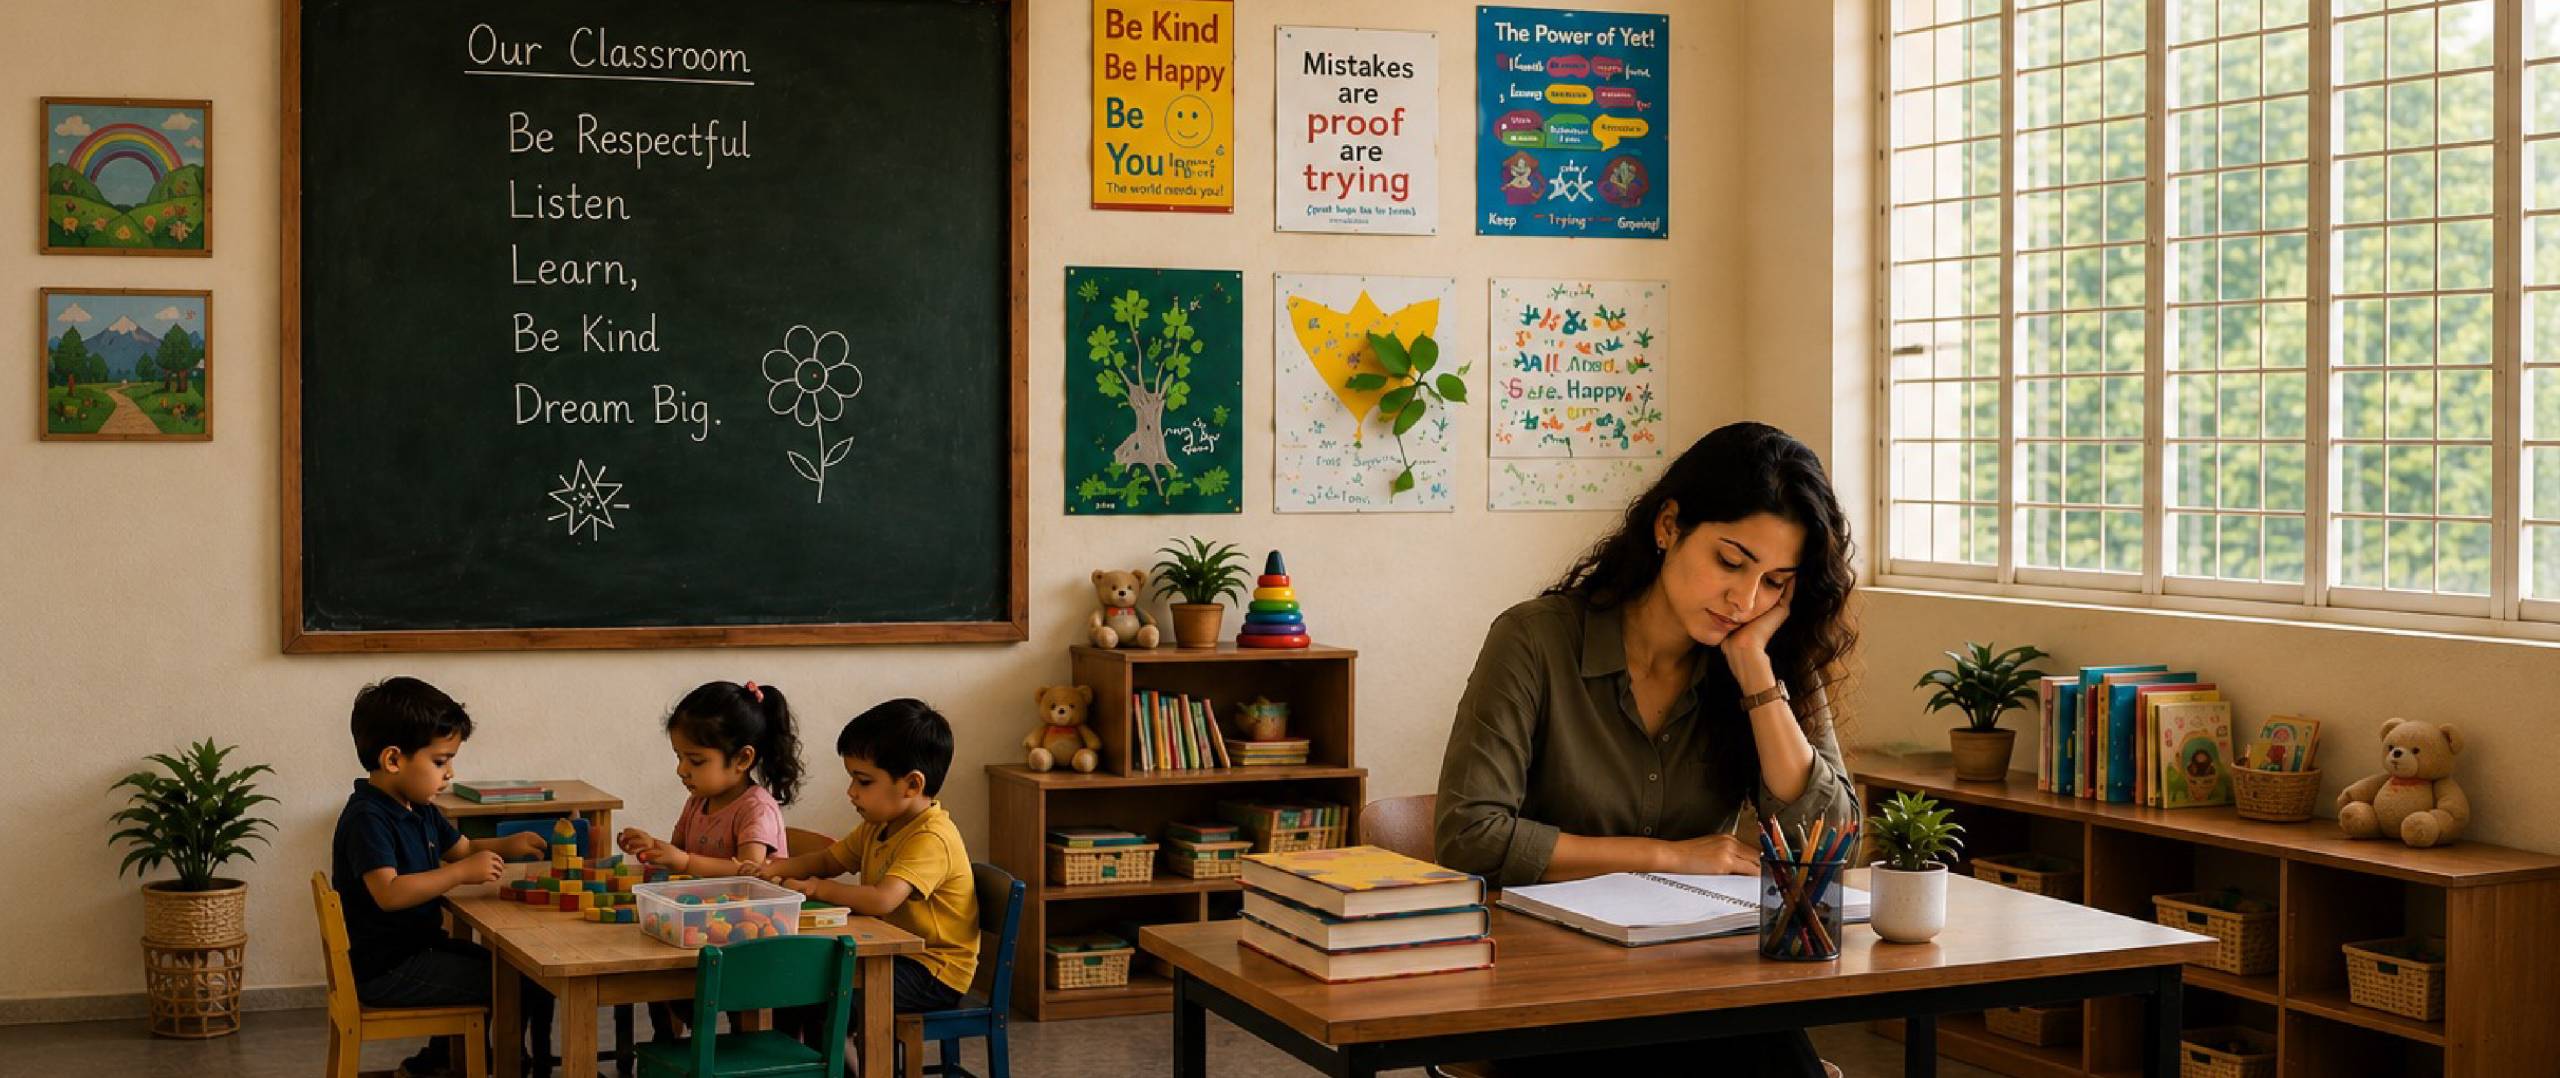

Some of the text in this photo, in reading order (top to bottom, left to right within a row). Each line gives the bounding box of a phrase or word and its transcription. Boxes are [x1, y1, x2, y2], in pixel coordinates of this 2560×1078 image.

[1106, 8, 1219, 44] Be Kind
[1494, 22, 1656, 48] The Power of Yet!
[468, 23, 751, 73] Our Classroom
[1303, 51, 1414, 79] Mistakes
[1105, 52, 1225, 92] Be Happy
[1106, 97, 1144, 129] Be
[1338, 86, 1379, 104] are
[509, 111, 751, 170] Be Respectful
[1308, 107, 1406, 143] proof
[1105, 142, 1164, 177] You
[1340, 145, 1383, 162] are
[509, 179, 630, 220] Listen
[1106, 182, 1127, 194] The
[1130, 183, 1162, 195] world
[1303, 164, 1409, 202] trying
[1488, 212, 1517, 230] Keep
[1549, 213, 1587, 230] Trying
[512, 243, 638, 291] Learn,
[513, 312, 660, 353] Be Kind
[1567, 379, 1626, 402] Happy
[515, 382, 722, 442] Dream Big.
